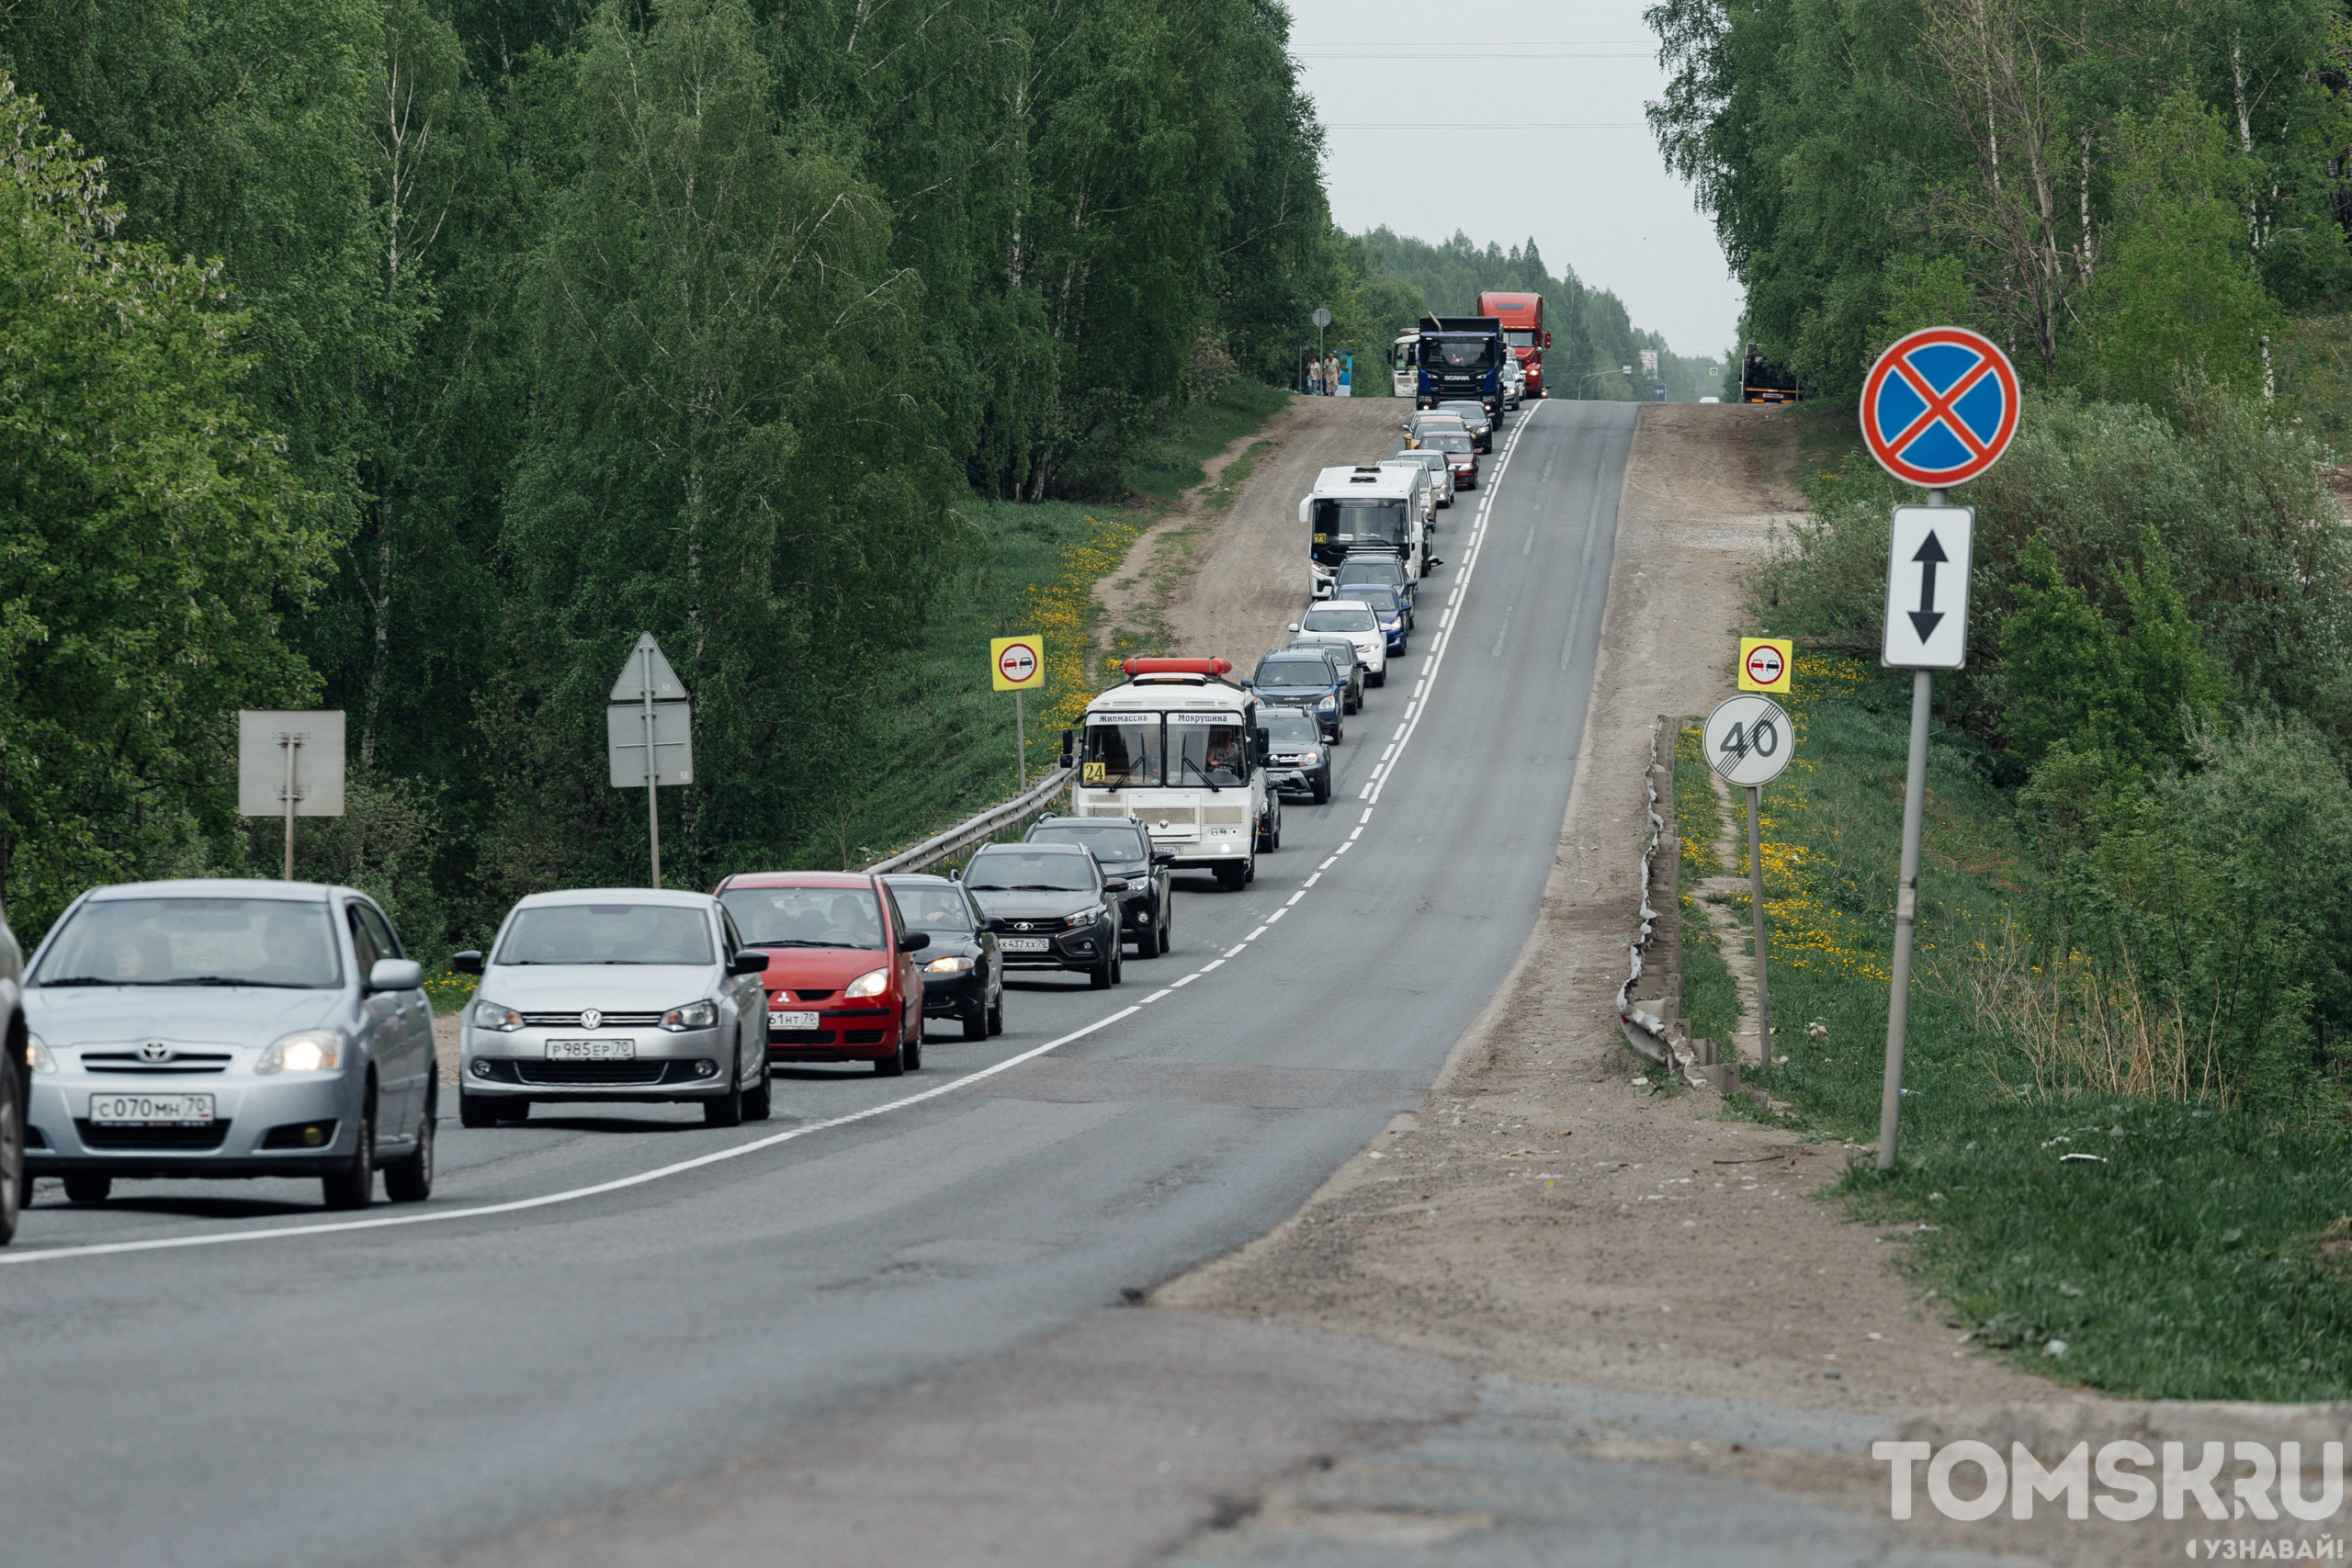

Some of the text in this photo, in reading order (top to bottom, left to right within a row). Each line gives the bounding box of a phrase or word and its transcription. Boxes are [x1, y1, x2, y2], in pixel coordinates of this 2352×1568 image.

[1315, 535, 1326, 543] 23
[1099, 714, 1228, 724] Жилмассив Мокрушина
[1720, 720, 1778, 758] 40
[1086, 764, 1104, 781] 24
